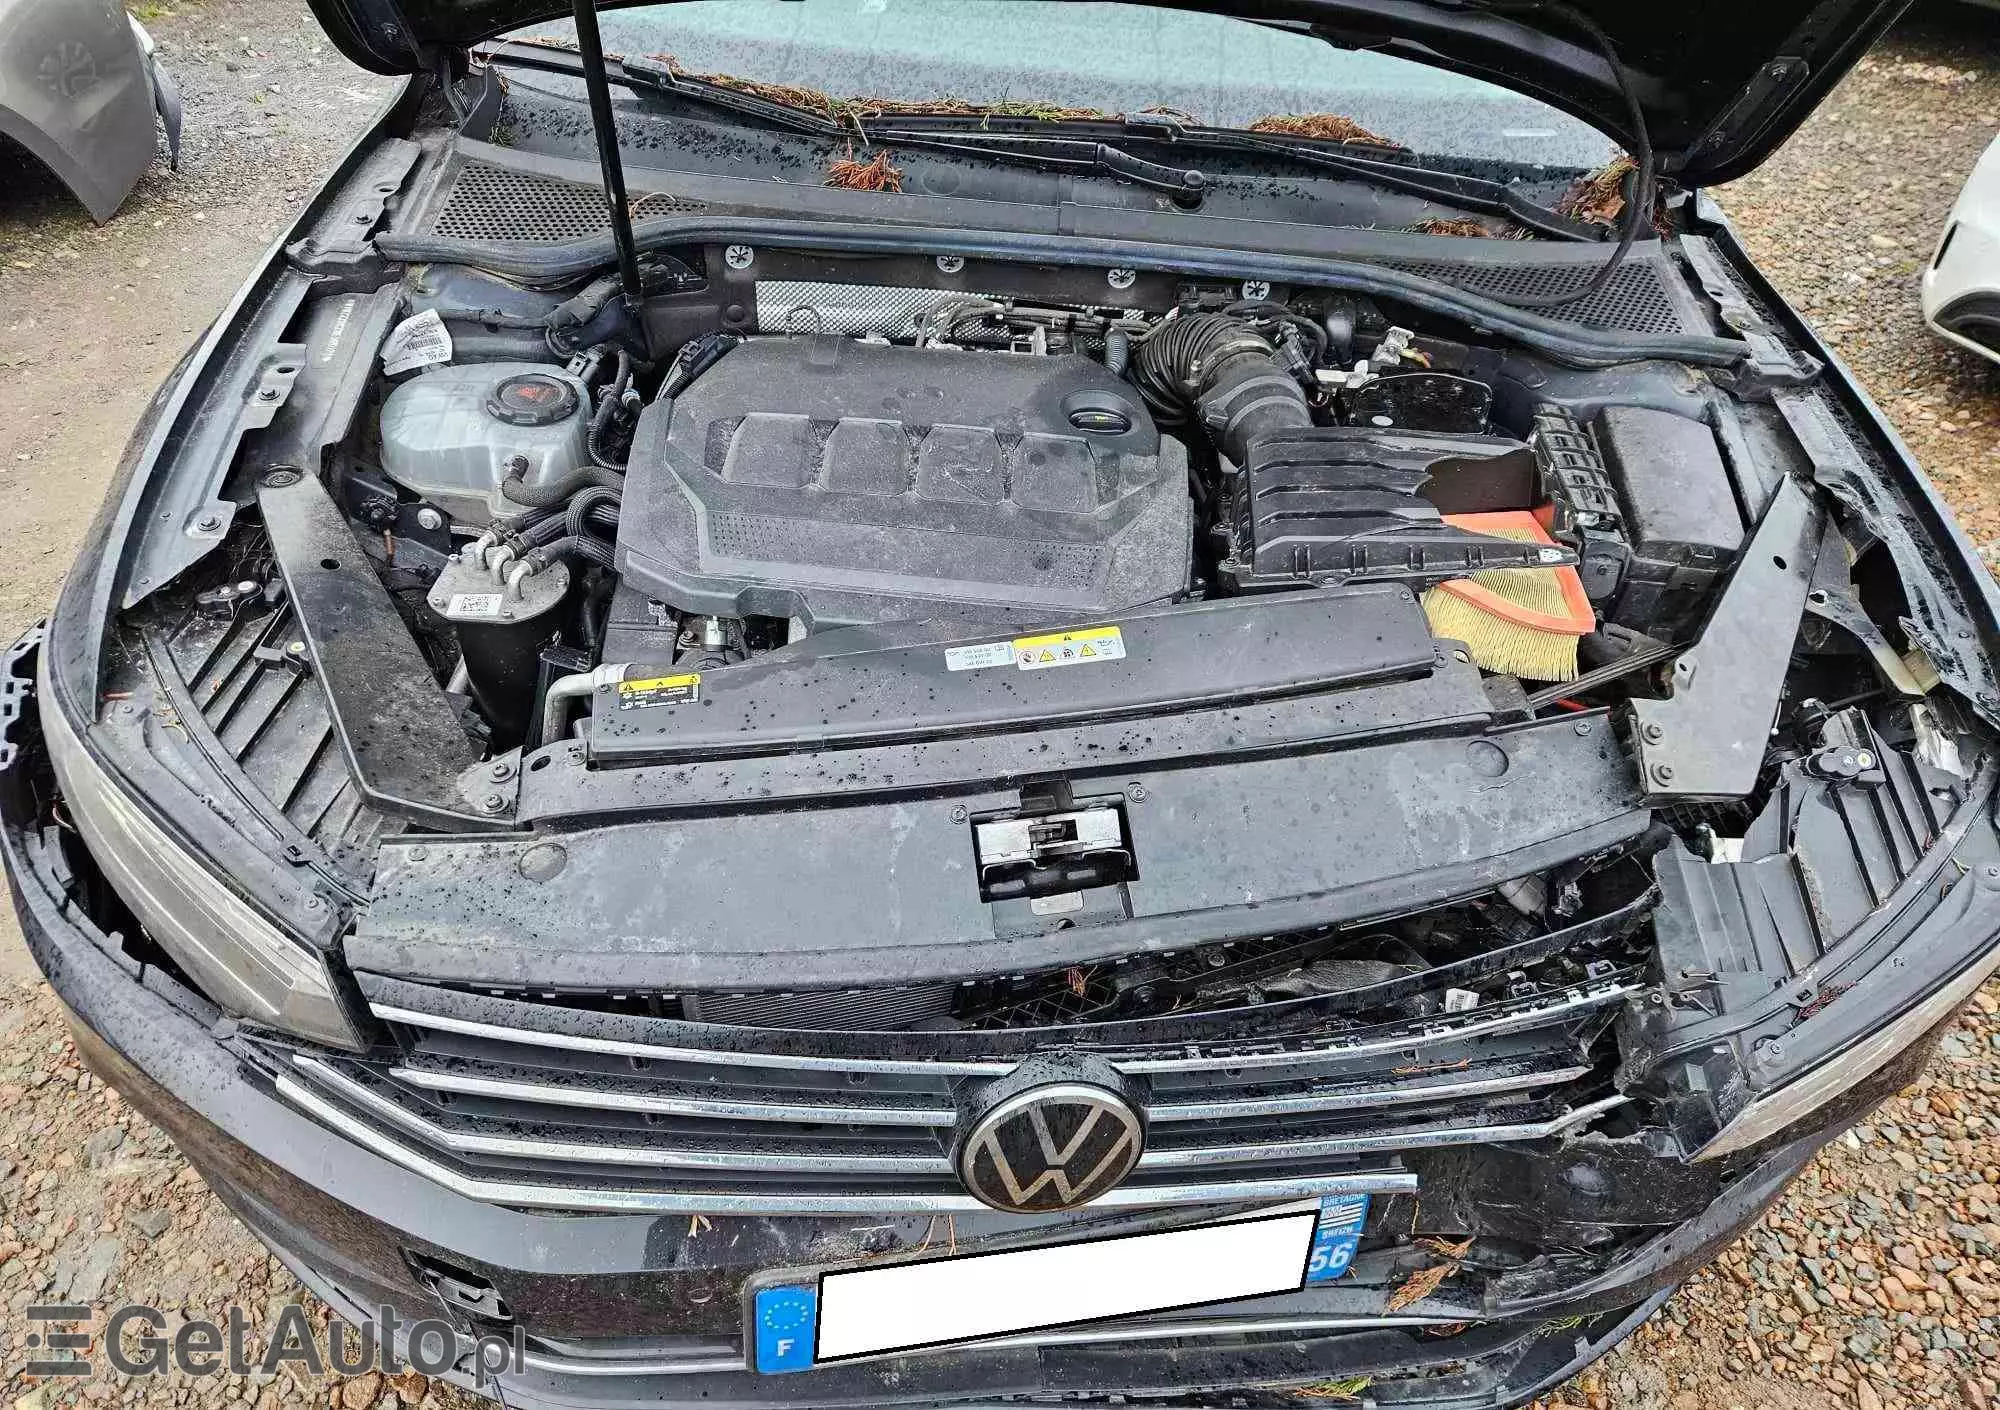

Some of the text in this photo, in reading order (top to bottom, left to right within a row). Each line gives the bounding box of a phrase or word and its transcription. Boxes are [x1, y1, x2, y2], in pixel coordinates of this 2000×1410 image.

[976, 1096, 1136, 1206] VW
[1308, 1242, 1353, 1273] 56
[777, 1338, 795, 1357] F
